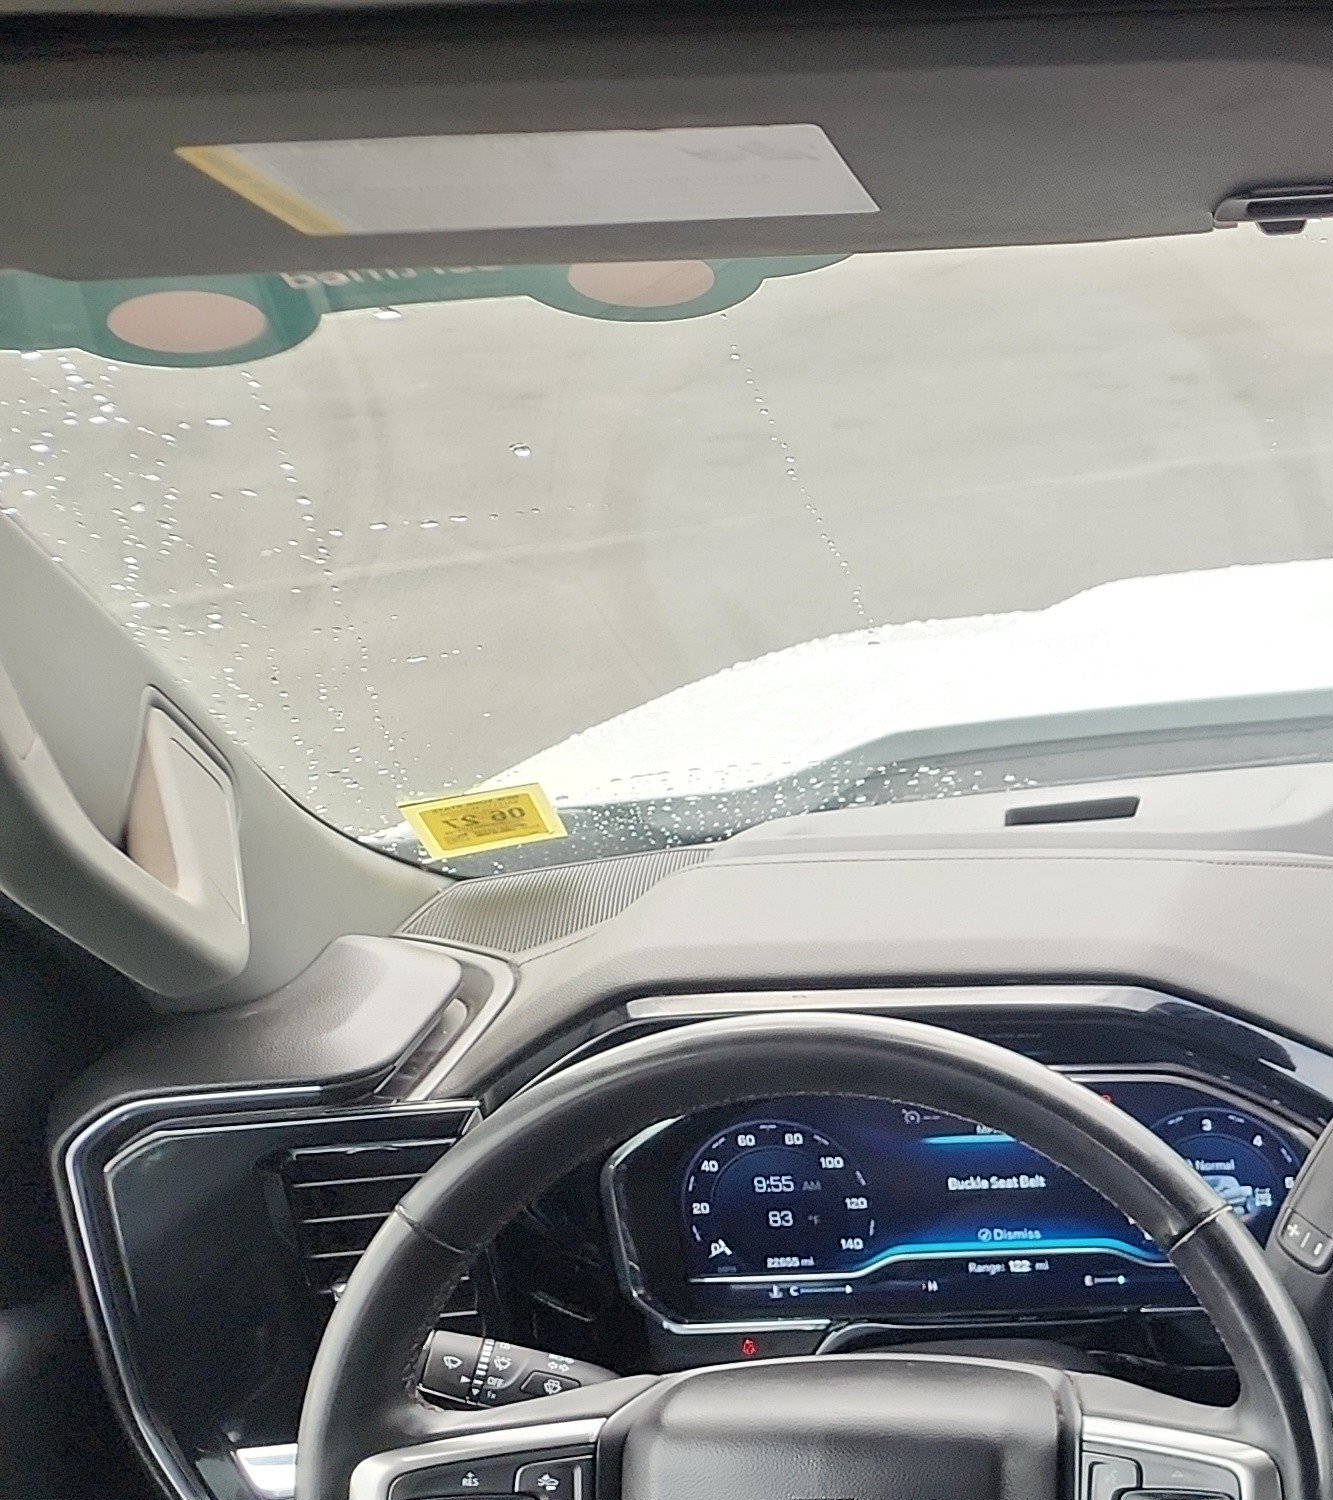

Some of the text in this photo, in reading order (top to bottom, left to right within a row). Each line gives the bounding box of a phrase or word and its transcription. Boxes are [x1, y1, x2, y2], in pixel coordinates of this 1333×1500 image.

[1201, 1119, 1212, 1131] 3
[737, 1135, 756, 1146] 60
[785, 1133, 804, 1146] 80
[1253, 1135, 1263, 1147] 4
[701, 1161, 719, 1172] 40
[820, 1157, 844, 1169] 100
[1196, 1159, 1235, 1171] Normal
[754, 1176, 822, 1193] 9:55 AM
[948, 1176, 989, 1191] Buckle
[990, 1175, 1019, 1189] Seat
[692, 1203, 710, 1214] 20
[845, 1198, 868, 1210] 120
[768, 1211, 794, 1227] 83
[993, 1228, 1042, 1241] Dismiss
[840, 1238, 863, 1250] 140
[801, 1256, 815, 1267] mi
[968, 1261, 1005, 1276] Range:
[1035, 1259, 1050, 1271] mi
[790, 1287, 799, 1297] C
[487, 1376, 505, 1388] OFF
[462, 1477, 479, 1487] RES
